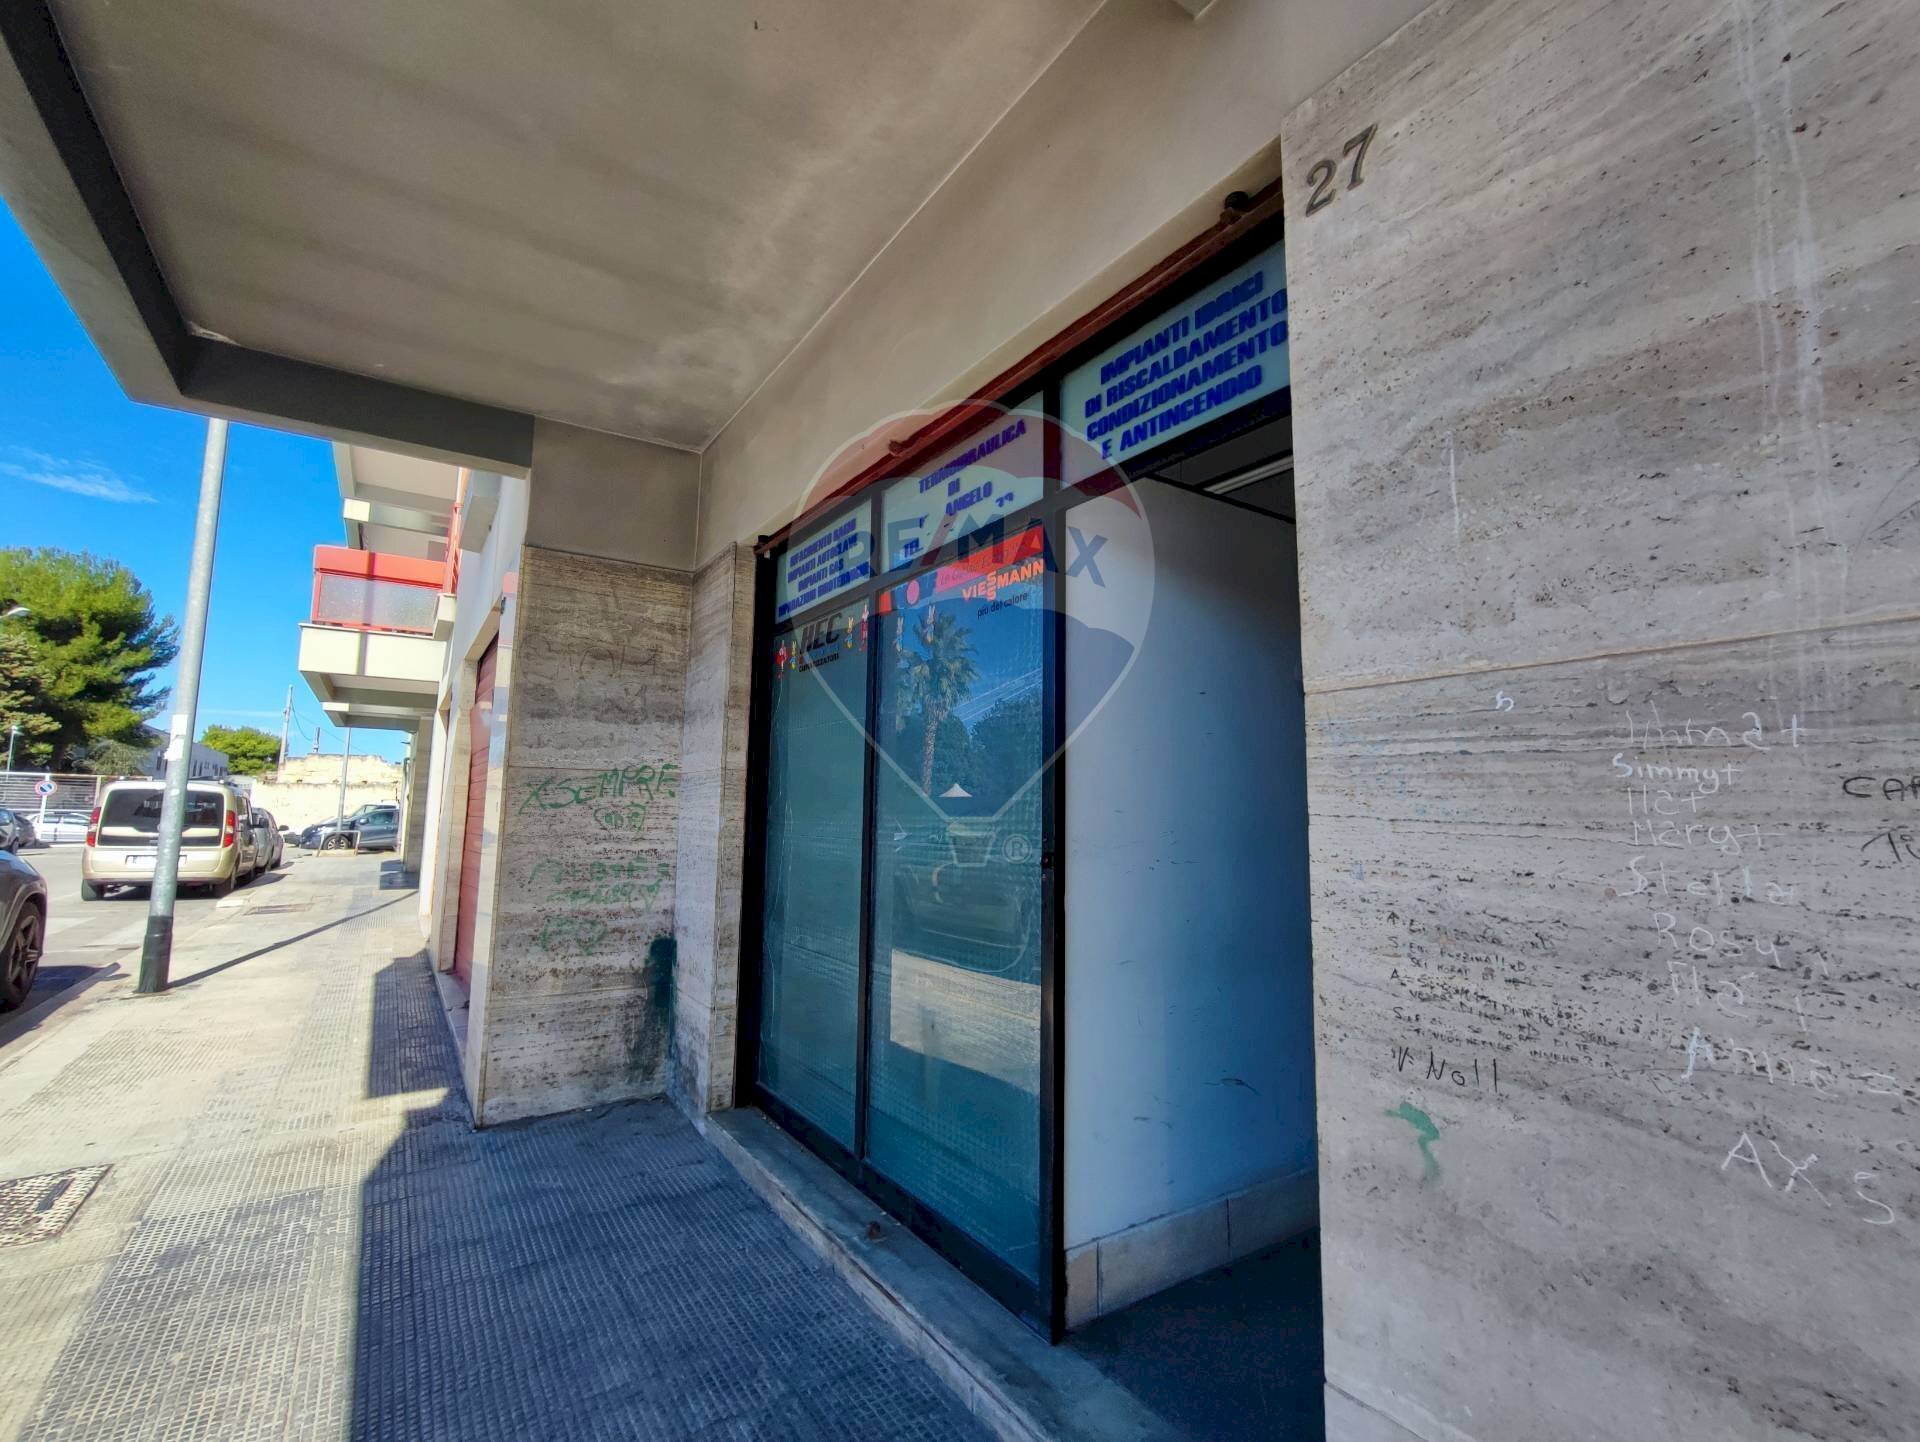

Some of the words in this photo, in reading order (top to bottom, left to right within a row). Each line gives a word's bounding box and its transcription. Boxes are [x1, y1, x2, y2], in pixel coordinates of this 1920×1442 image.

[1305, 123, 1378, 218] 27
[1085, 394, 1103, 418] DI
[1106, 288, 1288, 407] RISCALDAMENTO
[1086, 320, 1288, 441] CONDIZIONAMENTO
[1100, 316, 1189, 385] IMPIANTI
[1102, 438, 1113, 460] E
[1120, 364, 1263, 452] ANTINCENDIO
